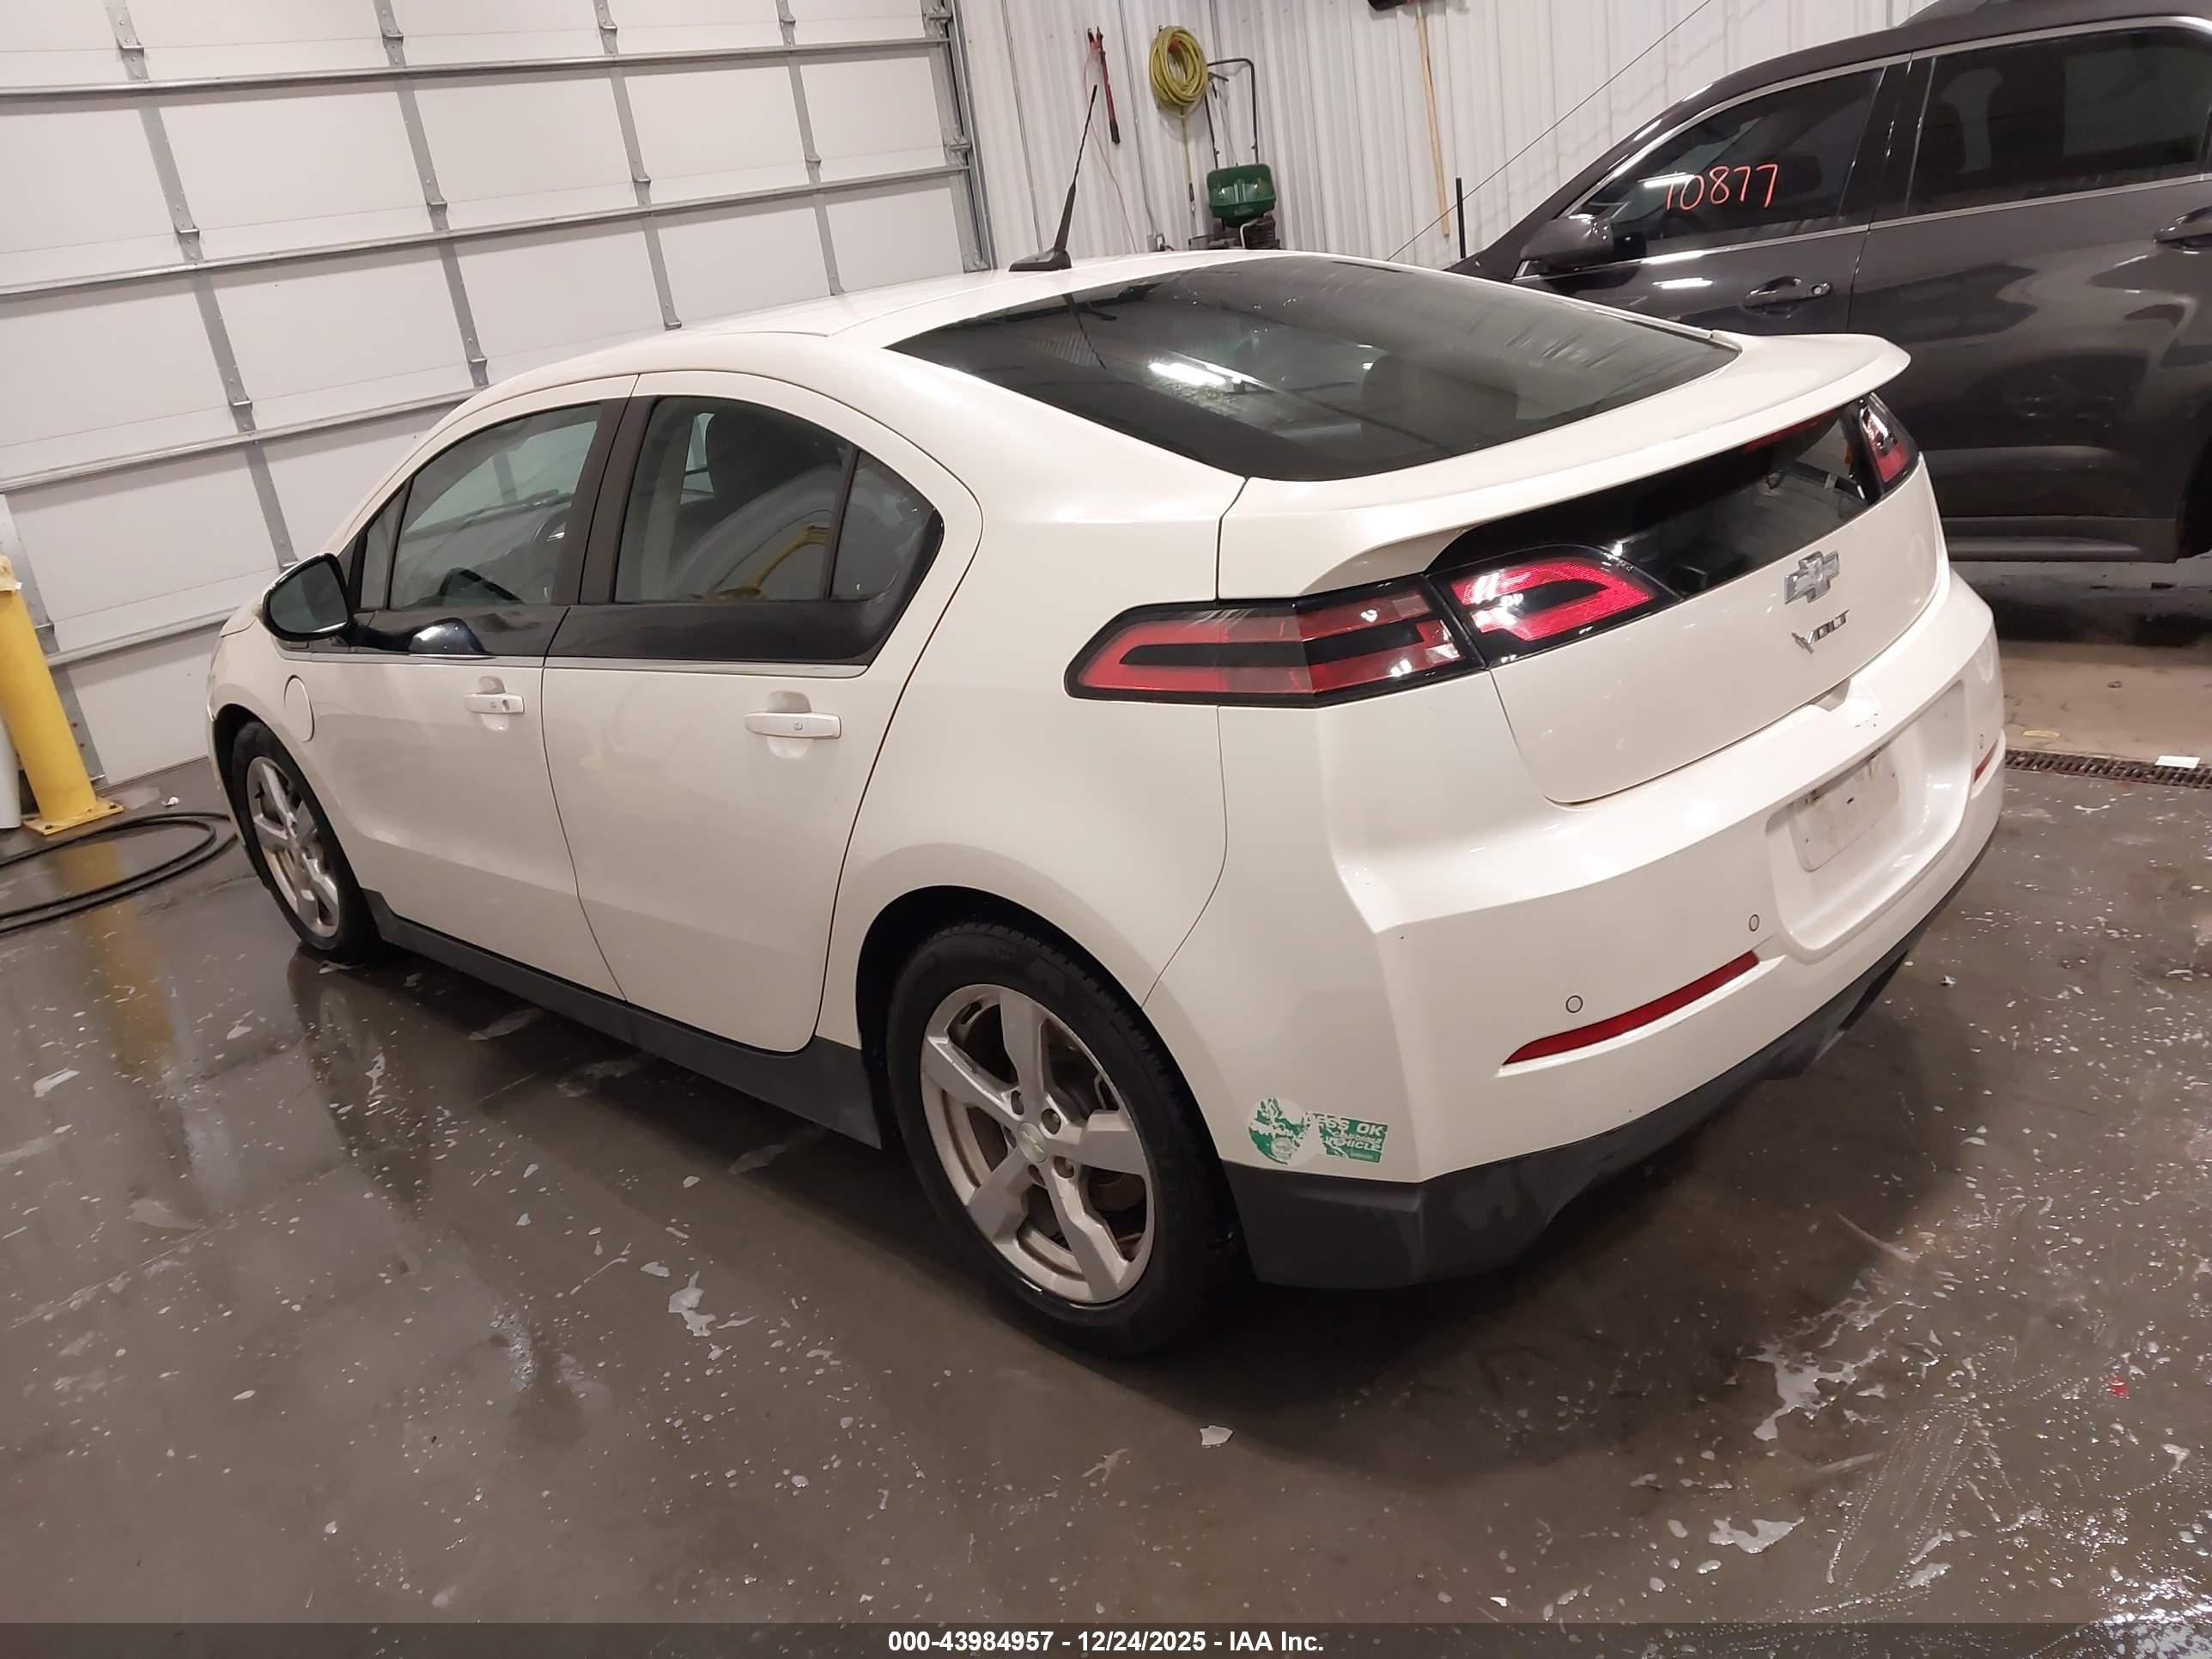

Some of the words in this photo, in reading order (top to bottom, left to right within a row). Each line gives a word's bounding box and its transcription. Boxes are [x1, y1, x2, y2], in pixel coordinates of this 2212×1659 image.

[1665, 163, 1778, 211] 10877
[1791, 609, 1850, 653] VOLT
[1356, 1122, 1384, 1137] OK
